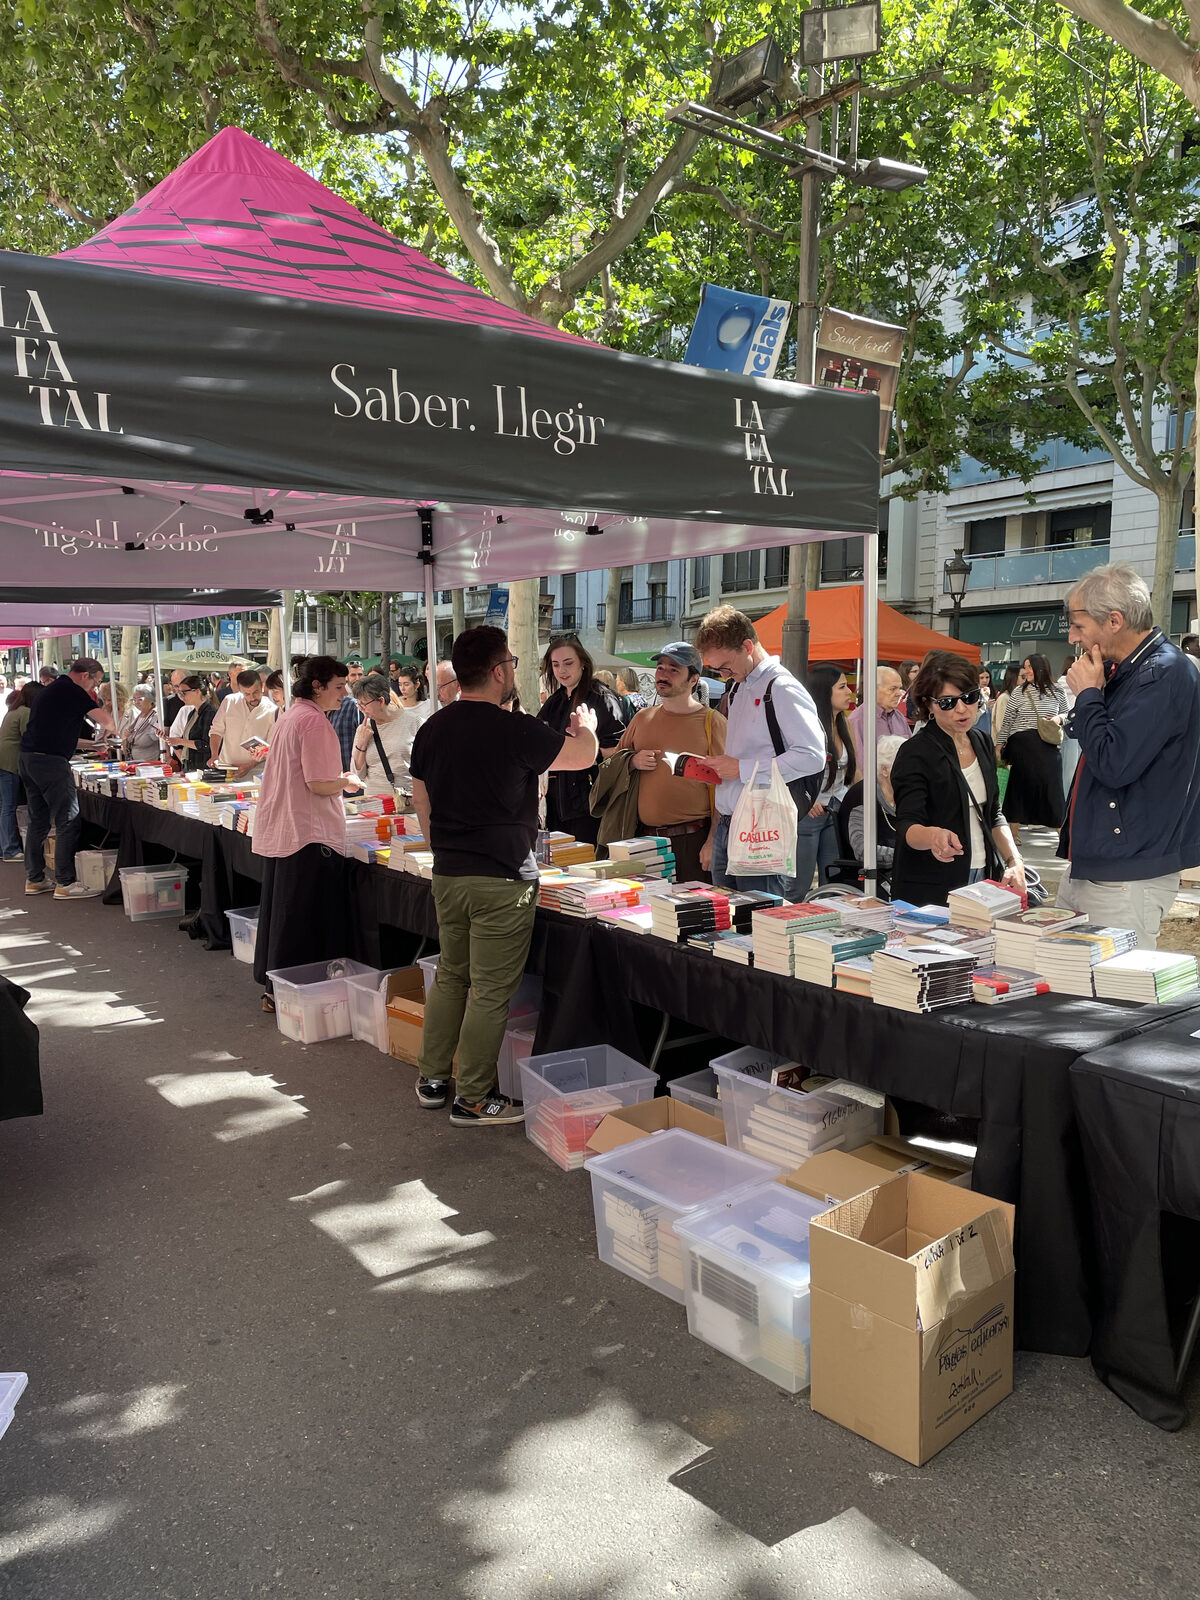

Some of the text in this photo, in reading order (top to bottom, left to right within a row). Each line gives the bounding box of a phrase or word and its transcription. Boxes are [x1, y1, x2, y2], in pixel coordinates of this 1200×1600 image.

[0, 286, 58, 334] LA
[828, 326, 892, 353] Sant Jordi
[11, 336, 78, 383] FA
[28, 385, 124, 434] TAL
[330, 363, 606, 455] Saber. Llegir
[733, 398, 766, 431] LA
[743, 432, 775, 463] FA
[749, 465, 794, 497] TAL
[1019, 619, 1047, 632] PSN
[486, 1104, 500, 1115] N
[968, 1224, 978, 1239] 2
